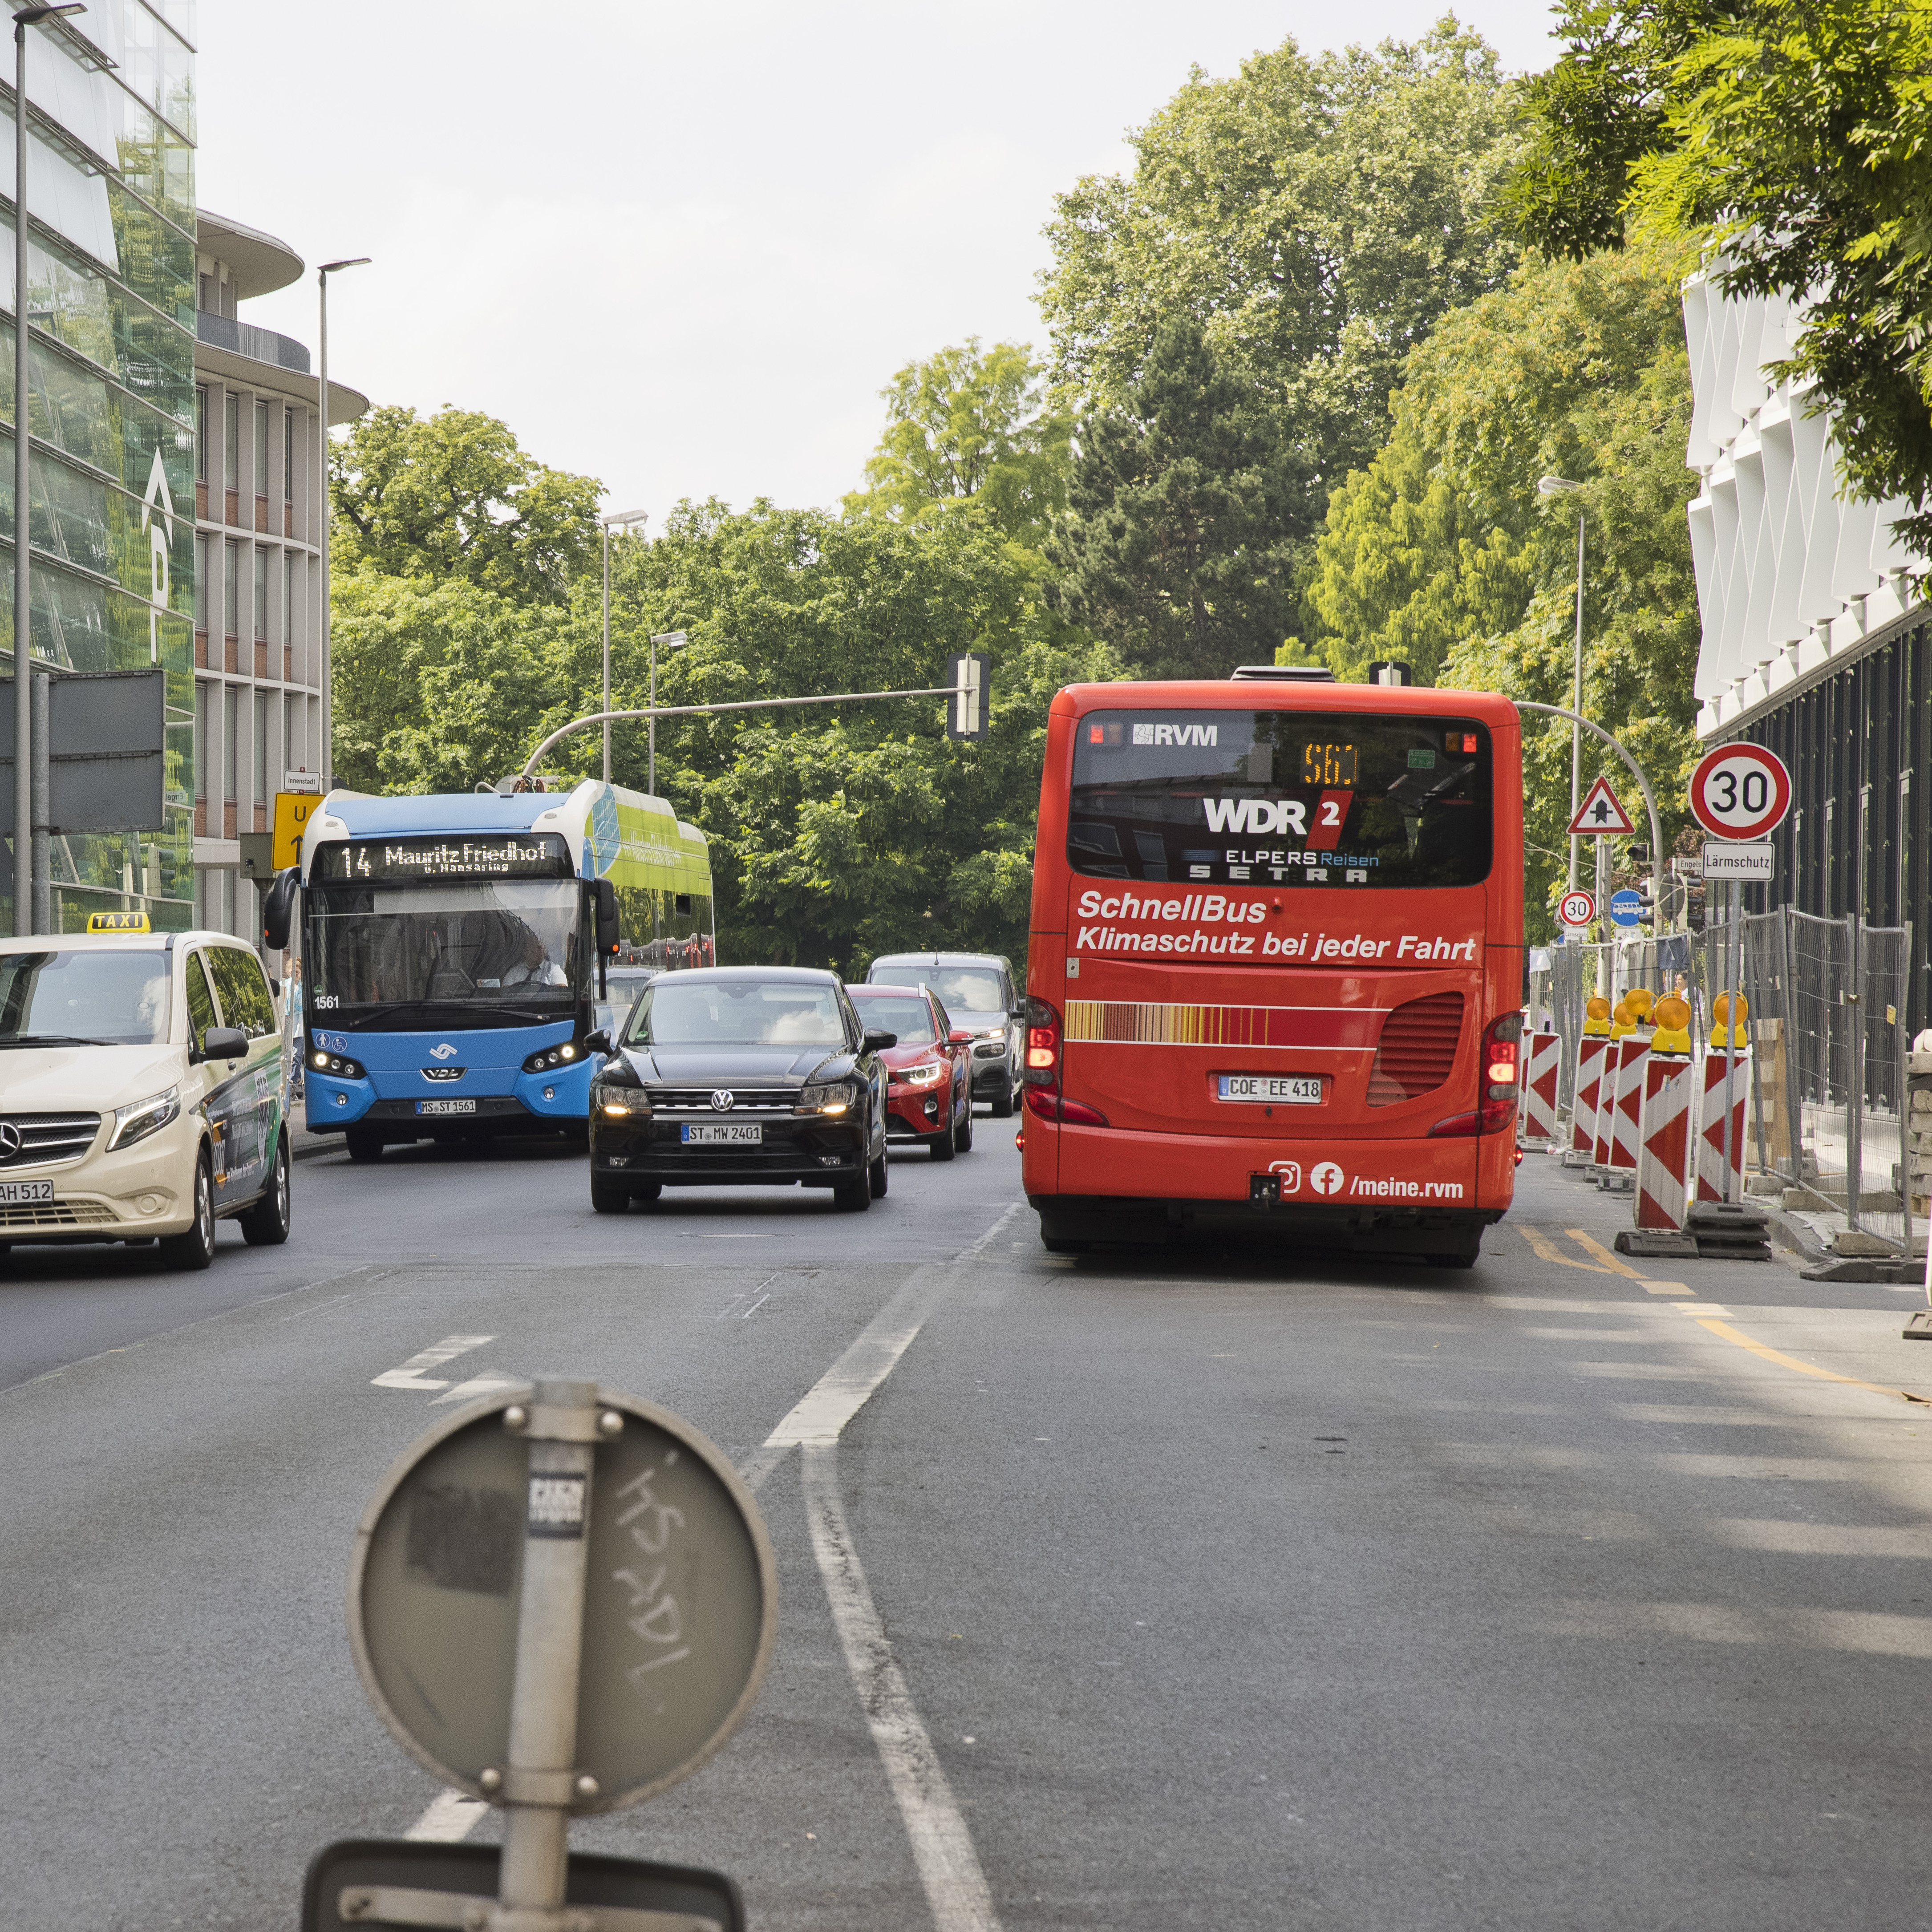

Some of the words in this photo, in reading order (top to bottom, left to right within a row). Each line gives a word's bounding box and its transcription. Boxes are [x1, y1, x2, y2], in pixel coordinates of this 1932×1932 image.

[1155, 724, 1217, 746] RVM
[1712, 771, 1767, 813] 30
[295, 806, 306, 822] U
[1203, 798, 1307, 834] WDR
[1321, 802, 1339, 825] 2
[385, 845, 459, 865] Mauritz
[464, 841, 547, 862] Friedhof
[1226, 851, 1316, 865] ELPERS
[1321, 853, 1379, 866] Reisen
[342, 847, 371, 877] 14
[440, 862, 508, 872] Hansaring
[1681, 860, 1701, 869] Engels
[1706, 855, 1769, 868] Lärmschutz
[1190, 865, 1367, 882] SETRA
[1077, 891, 1267, 923] SchnellBus
[1568, 902, 1586, 915] 30
[96, 915, 138, 927] TAXI
[1076, 926, 1255, 954] Klimaschutz
[1262, 932, 1308, 956] bei
[1310, 933, 1390, 961] jeder
[1397, 936, 1476, 960] Fahrt
[315, 996, 338, 1009] 1561
[1230, 1079, 1257, 1094] COE
[1270, 1081, 1288, 1095] EE
[1292, 1081, 1319, 1097] 418
[422, 1102, 433, 1112] MS
[440, 1102, 450, 1112] ST
[453, 1102, 474, 1111] 1561
[690, 1127, 704, 1139] ST
[714, 1127, 728, 1139] MW
[732, 1127, 760, 1139] 2401
[0, 1186, 17, 1200] AH
[21, 1184, 50, 1199] 512
[1349, 1176, 1463, 1198] /meine.rvm
